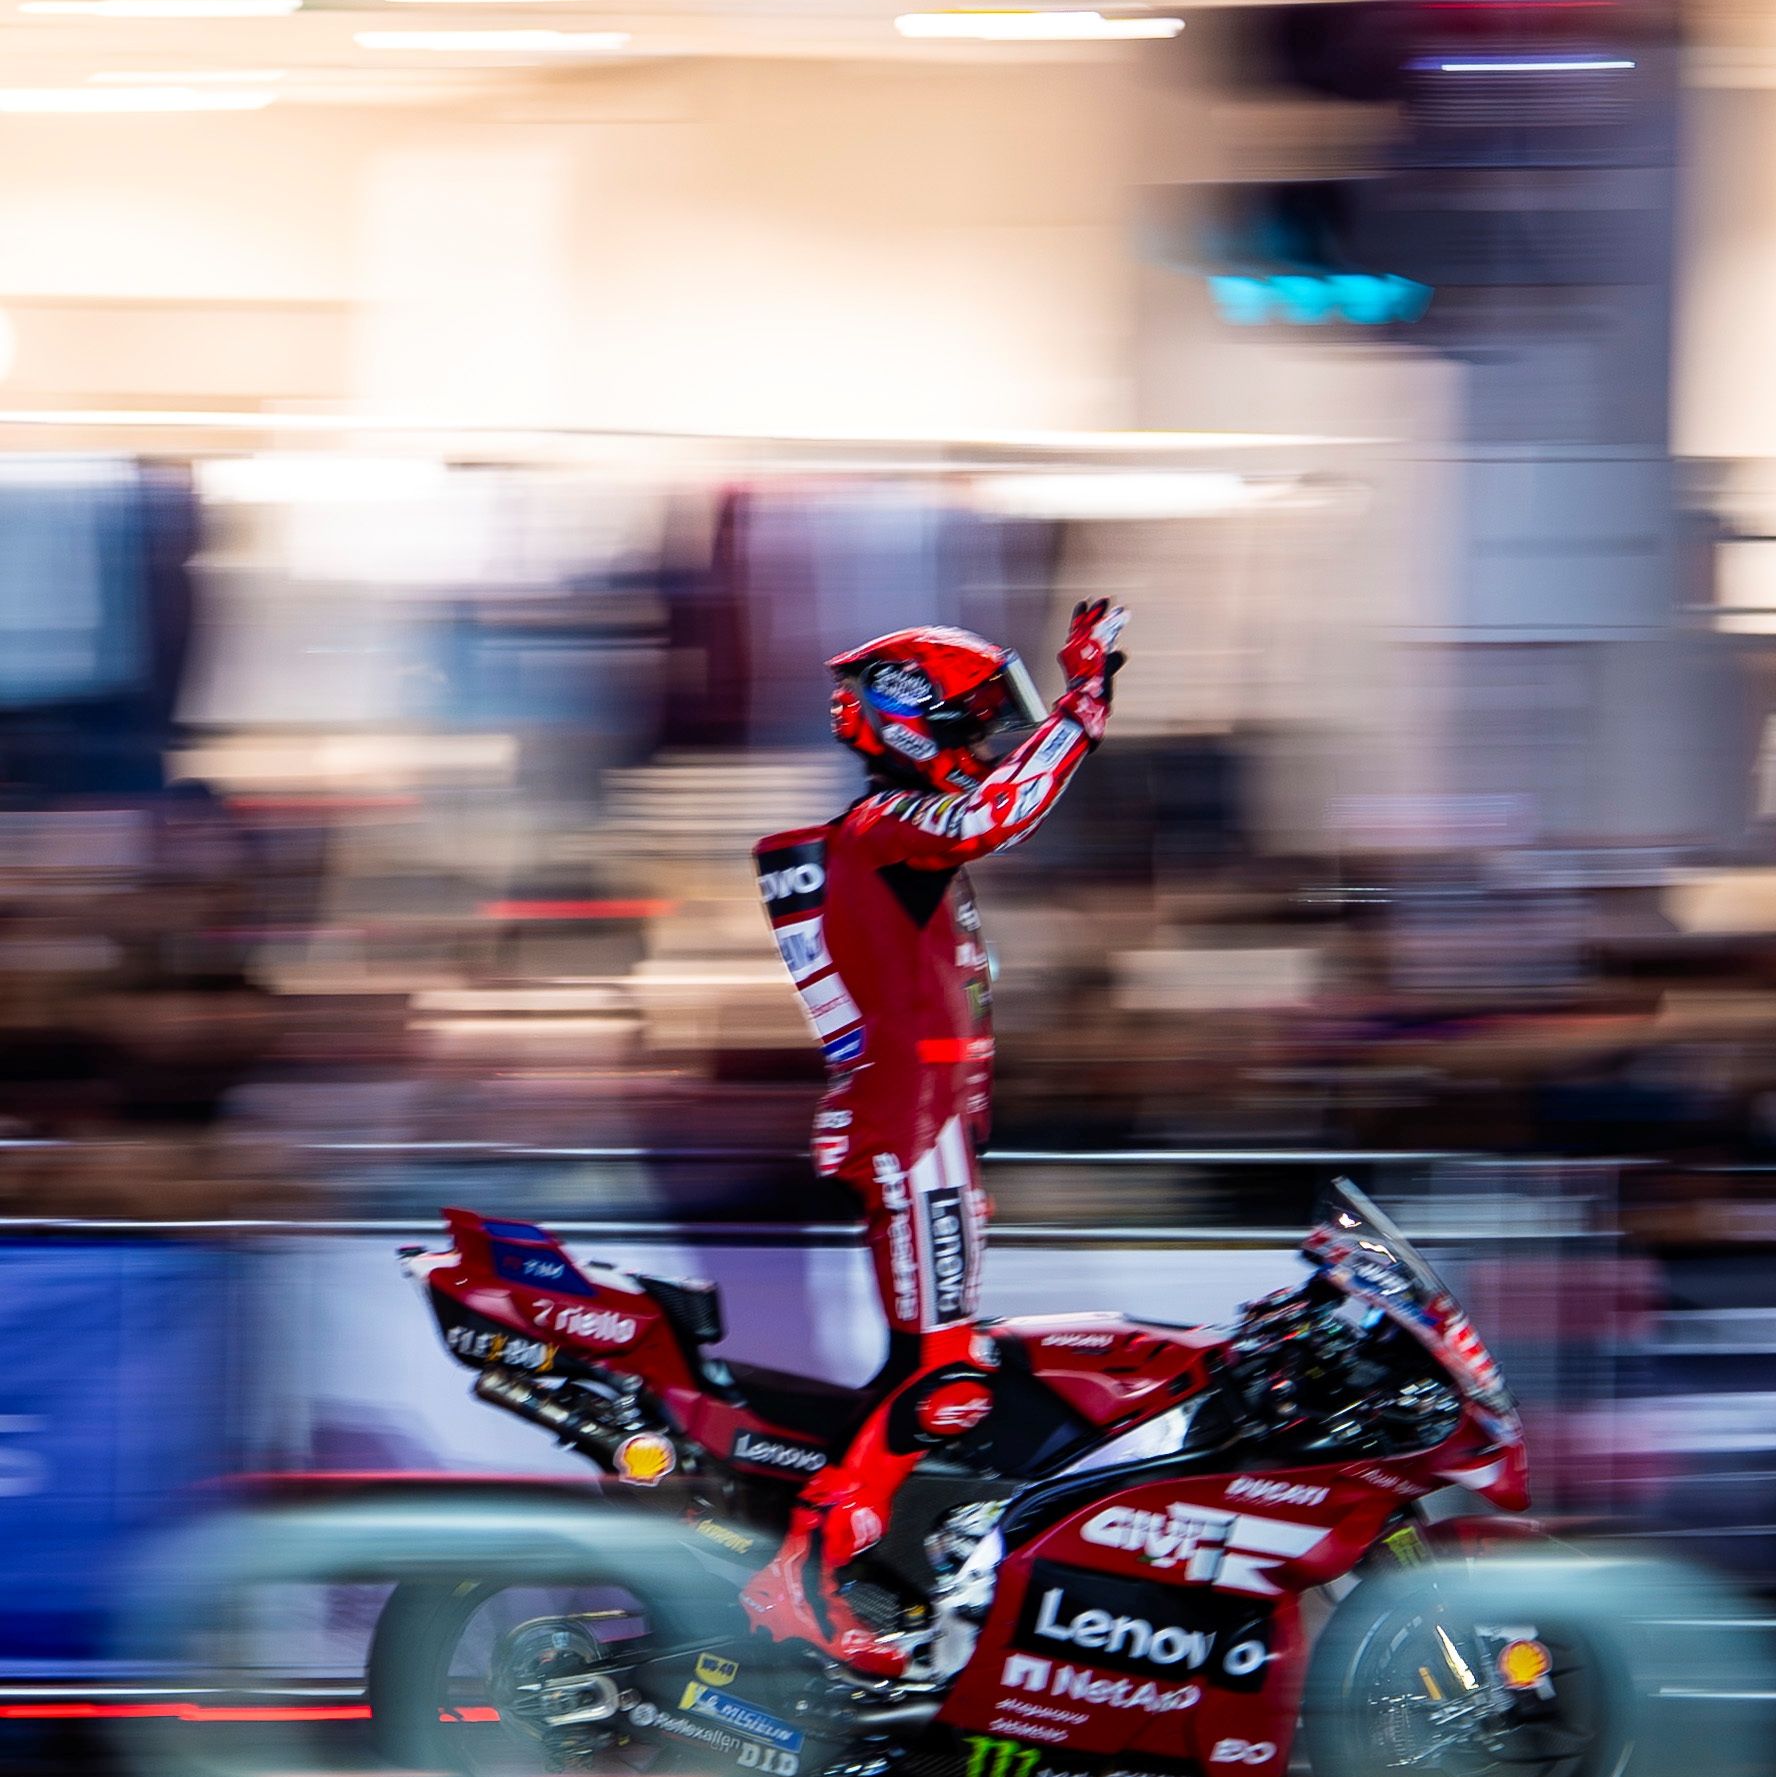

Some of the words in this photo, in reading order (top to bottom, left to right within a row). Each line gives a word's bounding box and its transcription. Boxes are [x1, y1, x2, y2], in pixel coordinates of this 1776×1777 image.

[931, 1197, 965, 1313] Lenovo
[1224, 1475, 1331, 1506] DUCATI
[1034, 1587, 1267, 1676] Lenovo
